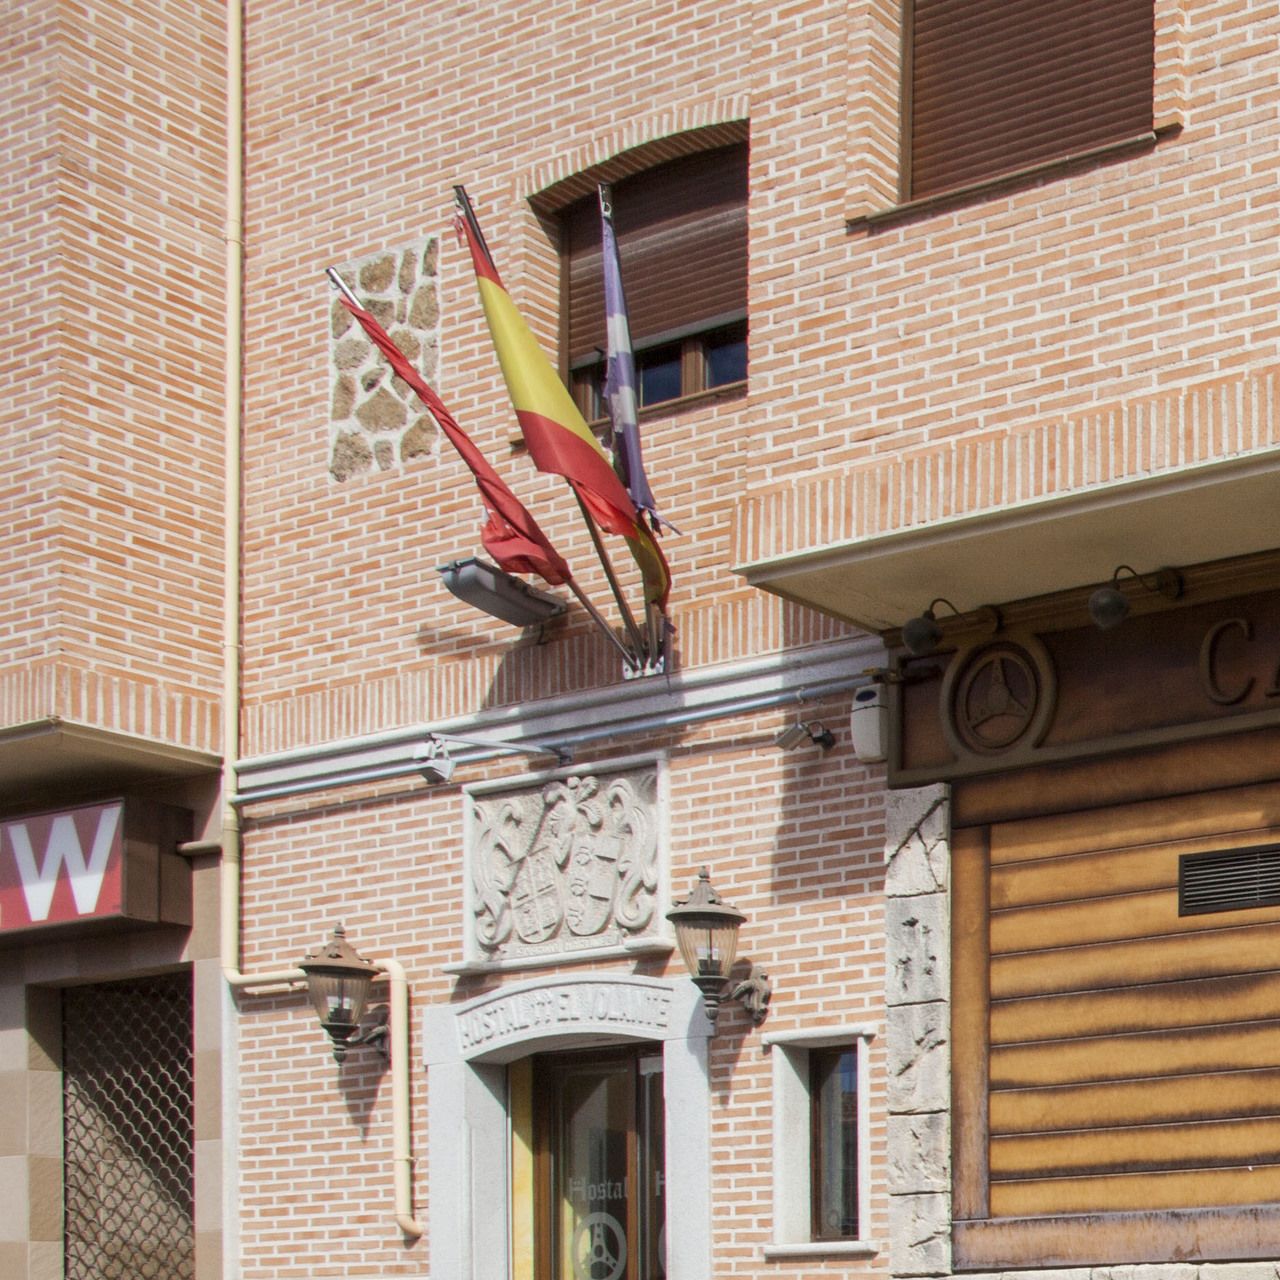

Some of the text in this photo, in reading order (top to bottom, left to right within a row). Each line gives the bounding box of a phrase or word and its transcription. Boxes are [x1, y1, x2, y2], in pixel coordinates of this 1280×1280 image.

[458, 985, 671, 1050] HOSTAL EL VOLANTE
